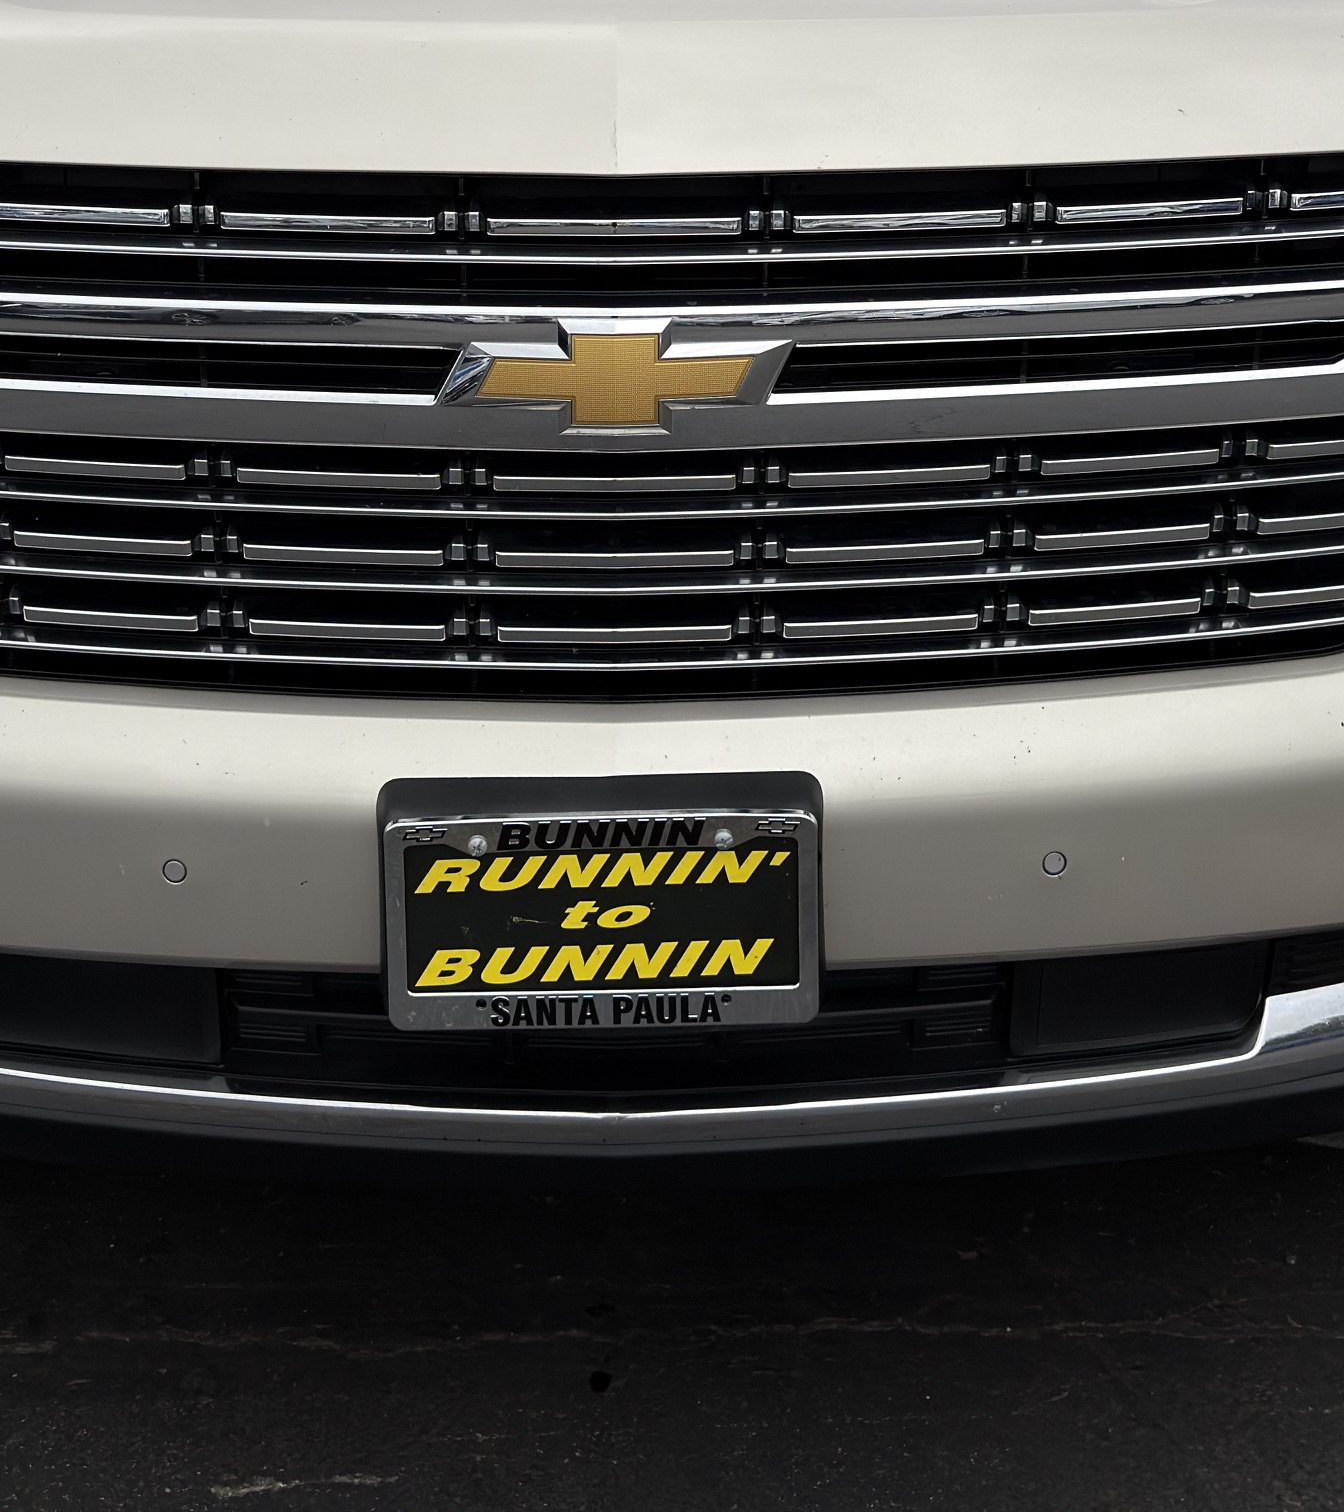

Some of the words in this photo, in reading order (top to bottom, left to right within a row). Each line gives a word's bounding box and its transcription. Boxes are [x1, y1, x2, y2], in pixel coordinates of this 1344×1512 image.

[497, 818, 706, 852] BUNNIN
[414, 851, 791, 894] RUNNIN'
[560, 900, 652, 930] to
[414, 938, 775, 988] BUNNIN
[489, 995, 600, 1028] SANTA
[612, 992, 722, 1025] PAULA
